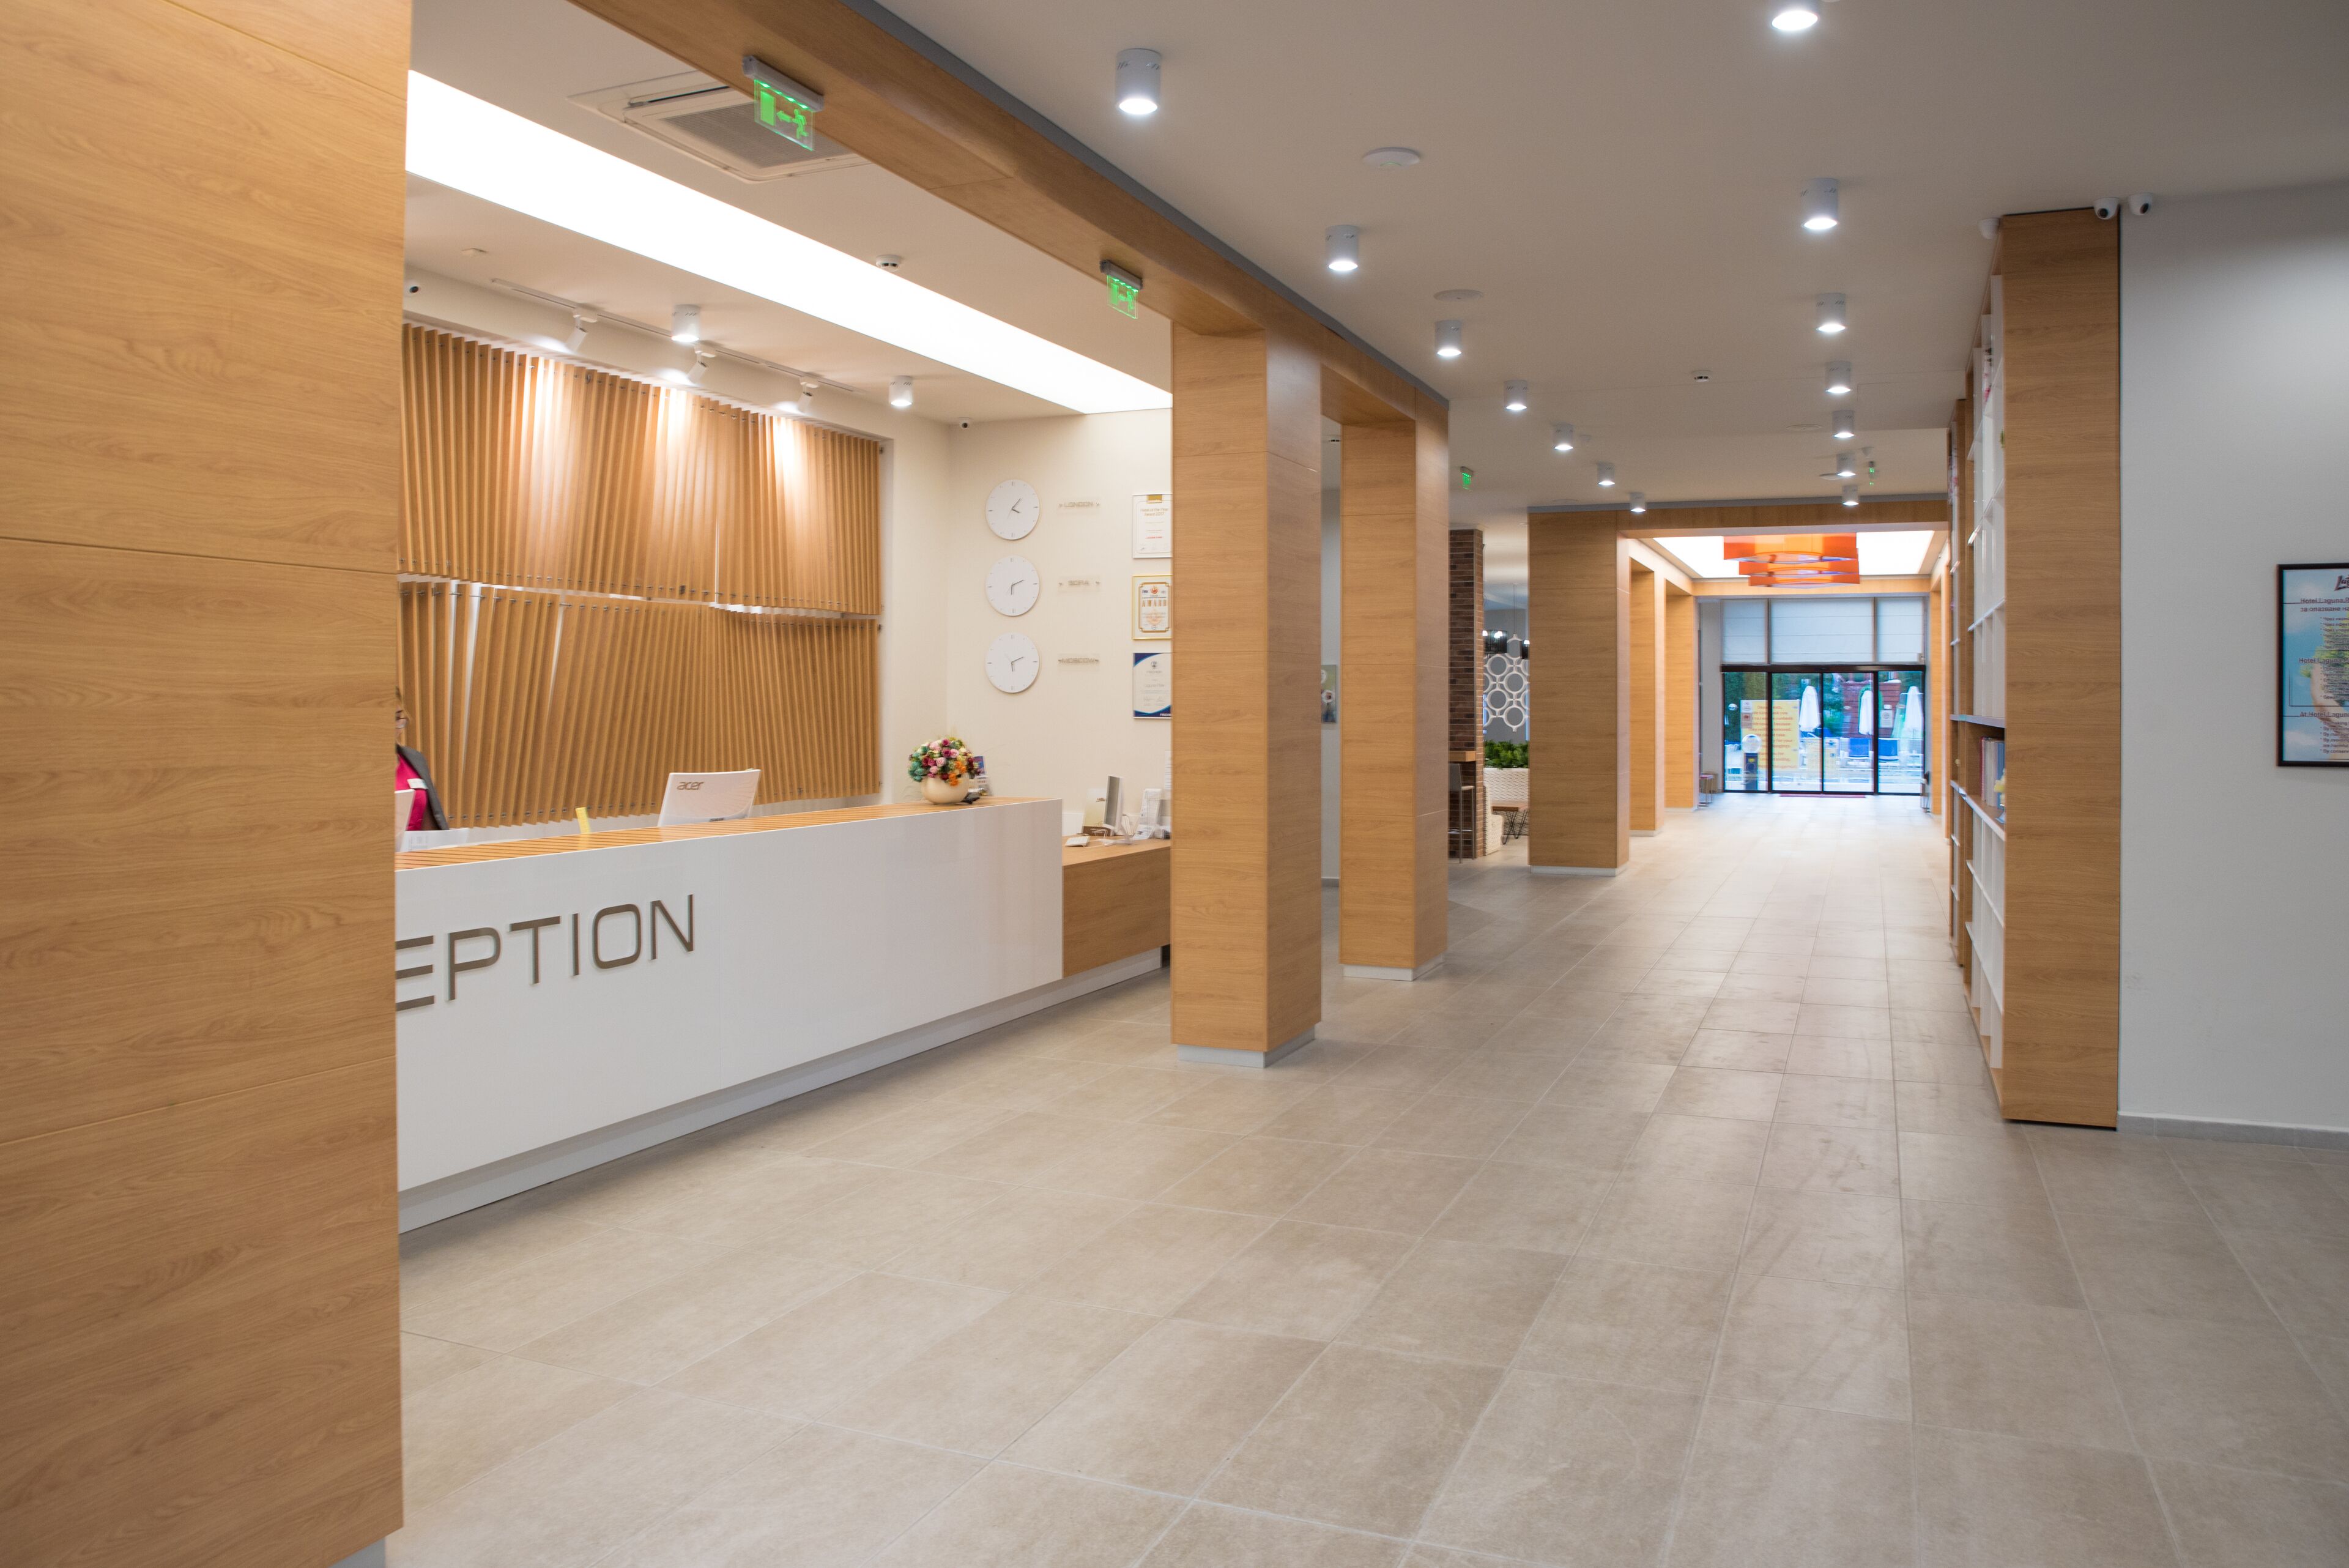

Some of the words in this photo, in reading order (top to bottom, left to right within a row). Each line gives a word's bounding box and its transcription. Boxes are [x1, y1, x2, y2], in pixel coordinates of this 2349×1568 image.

[1141, 599, 1167, 608] AWARD
[677, 781, 704, 790] acer
[395, 894, 694, 1013] EPTION
